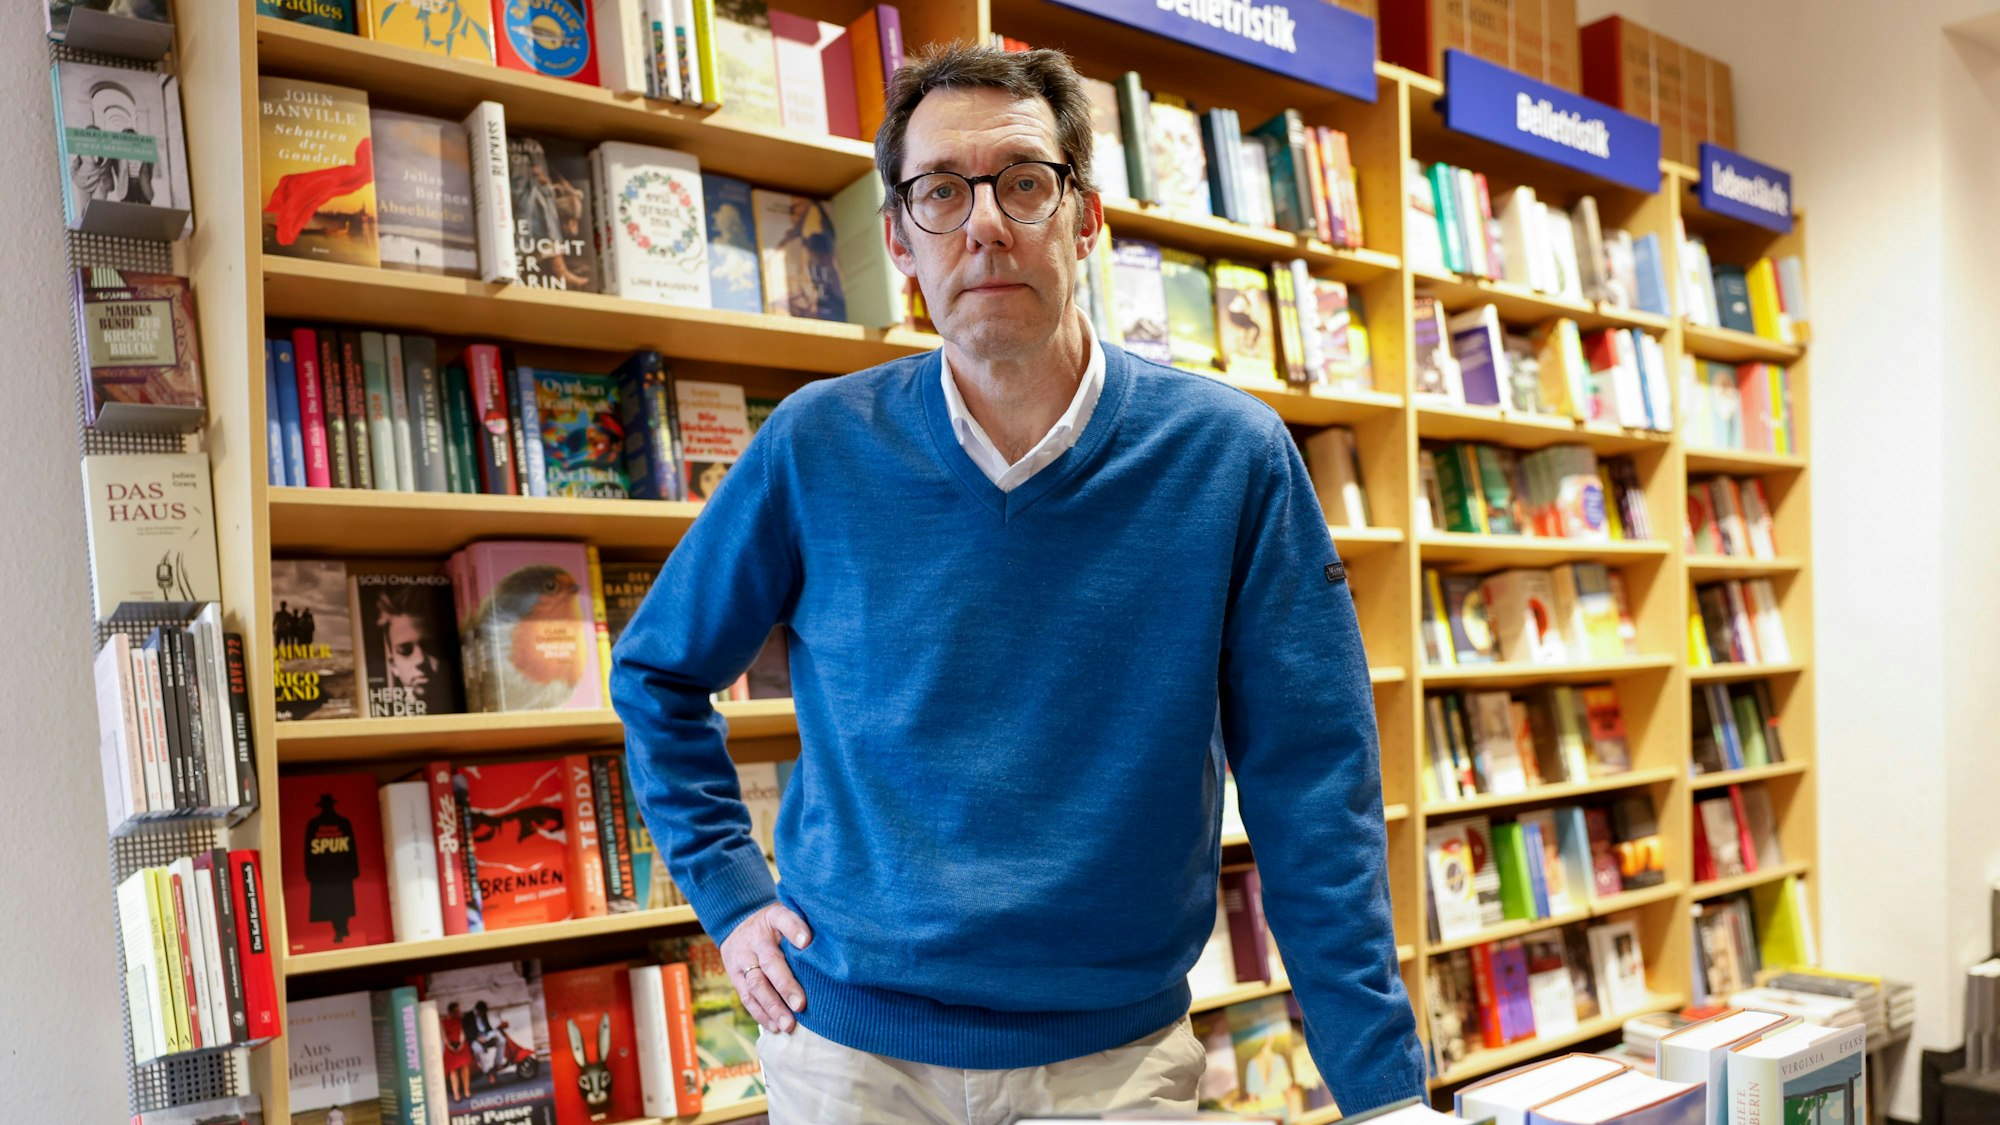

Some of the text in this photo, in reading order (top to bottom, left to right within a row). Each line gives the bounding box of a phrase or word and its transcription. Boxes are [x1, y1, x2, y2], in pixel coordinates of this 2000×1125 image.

[284, 89, 334, 107] JOHN
[263, 101, 356, 126] BANVILLE
[274, 123, 347, 142] Schatten
[1516, 92, 1611, 160] Belletristik
[299, 137, 326, 151] der
[278, 148, 348, 166] Gondeln
[403, 169, 443, 185] Julian
[105, 304, 152, 317] MARKUS
[99, 318, 136, 330] BUNDI
[106, 482, 164, 500] DAS
[109, 503, 187, 522] HAUS
[228, 639, 245, 694] CAVE 72
[370, 688, 415, 705] HERZ
[393, 700, 427, 716] DER
[573, 767, 598, 849] TEDDY
[311, 836, 350, 855] SPUK
[479, 868, 564, 900] BRENNEN
[300, 1043, 332, 1059] Aus
[1781, 1035, 1864, 1076] VIRGINIA EVANS
[322, 1070, 360, 1090] Holz
[482, 1105, 534, 1124] Pause
